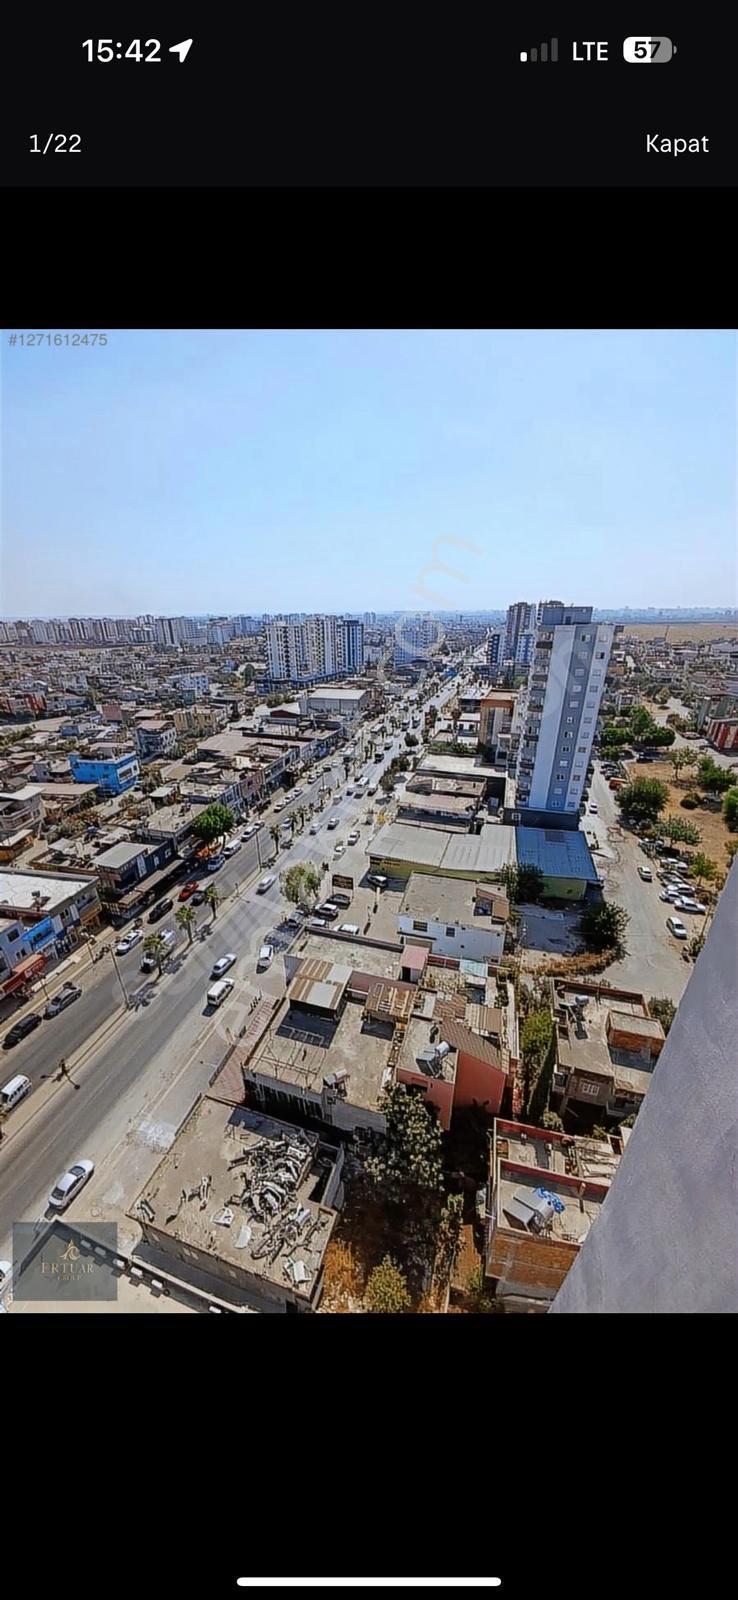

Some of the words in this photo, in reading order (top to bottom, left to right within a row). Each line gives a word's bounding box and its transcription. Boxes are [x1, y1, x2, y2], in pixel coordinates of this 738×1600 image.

[82, 39, 161, 62] 15:42
[573, 41, 608, 61] LTE
[634, 41, 661, 59] 57
[29, 134, 82, 155] 1/22
[646, 134, 709, 156] Kapat
